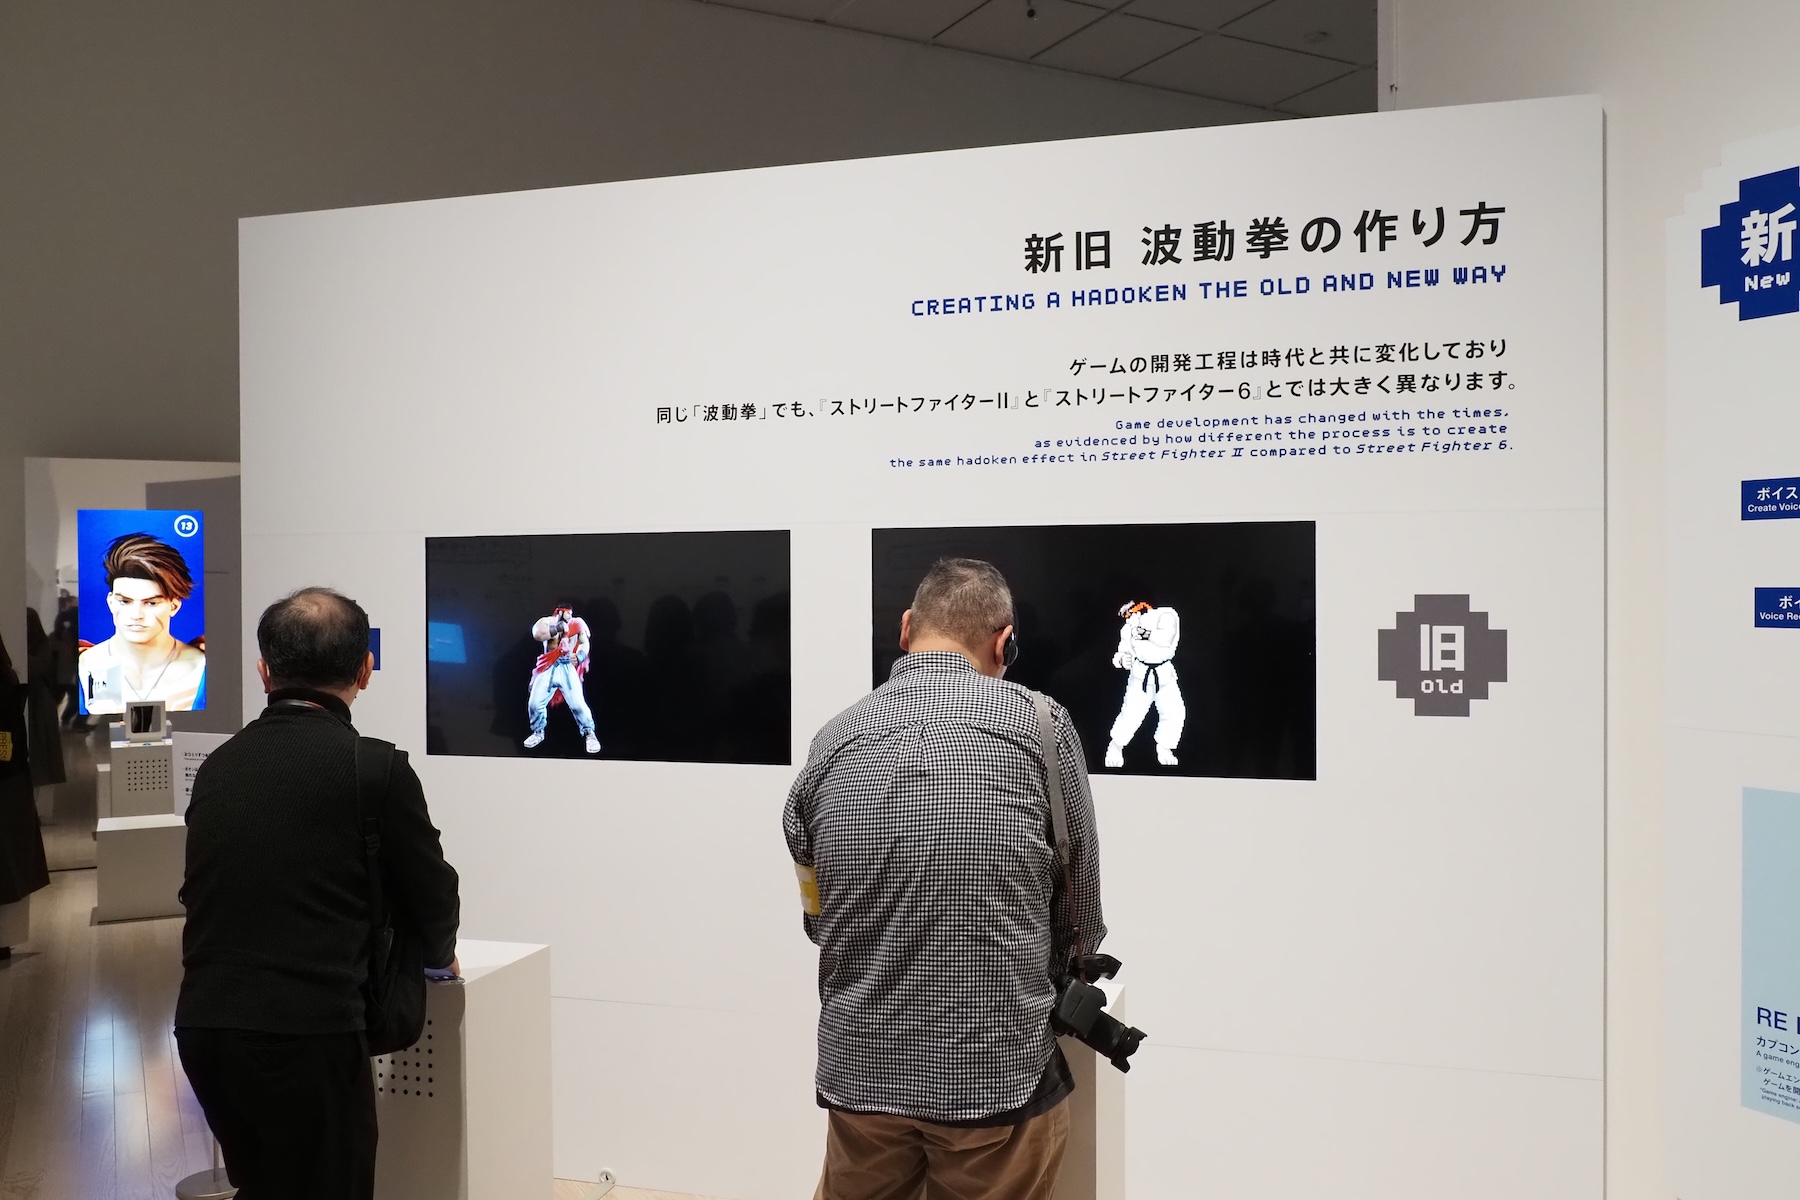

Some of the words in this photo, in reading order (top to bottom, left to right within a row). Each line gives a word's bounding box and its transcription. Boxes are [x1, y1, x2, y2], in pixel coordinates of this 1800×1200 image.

[1024, 230, 1110, 274] 新旧
[1141, 201, 1505, 266] 波動拳の作り方
[1740, 202, 1797, 267] 新
[912, 293, 1035, 316] CREATING
[1047, 292, 1059, 308] A
[1072, 284, 1186, 307] HADOKEN
[1199, 280, 1247, 299] THE
[1260, 277, 1309, 296] OLD
[1323, 273, 1373, 292] AND
[1388, 269, 1439, 288] NEW
[1453, 265, 1506, 285] WAY
[1744, 272, 1791, 292] New
[1070, 339, 1507, 376] ゲームの開発工程は時代と共に変化しており
[1116, 421, 1150, 429] Game
[1157, 417, 1258, 428] development
[1265, 415, 1292, 424] has
[1299, 411, 1365, 424] changed
[1373, 410, 1410, 421] with
[1417, 409, 1445, 419] the
[1035, 440, 1050, 448] as
[1057, 435, 1136, 447] evidenced
[1143, 435, 1159, 446] by
[1166, 434, 1192, 443] how
[1198, 432, 1282, 442] different
[1289, 430, 1315, 439] the
[1323, 429, 1390, 440] process
[1397, 426, 1415, 436] is
[1422, 427, 1440, 435] to
[1448, 425, 1507, 435] create
[890, 458, 913, 467] the
[957, 455, 1016, 465] hadoken
[1023, 454, 1074, 463] effect
[1080, 452, 1096, 461] in
[1102, 451, 1156, 461] Street
[1161, 449, 1226, 460] Fighter
[1250, 445, 1326, 458] compared
[1333, 446, 1350, 454] to
[1356, 443, 1415, 453] Street
[1421, 441, 1492, 453] Fighter
[1498, 440, 1512, 450] 6.
[1757, 486, 1798, 501] ボイス
[1747, 504, 1777, 512] Create
[1759, 612, 1784, 620] Voice
[1787, 612, 1800, 620] Re
[1420, 624, 1465, 671] 旧
[1757, 1006, 1788, 1031] RE
[1763, 1053, 1784, 1063] game
